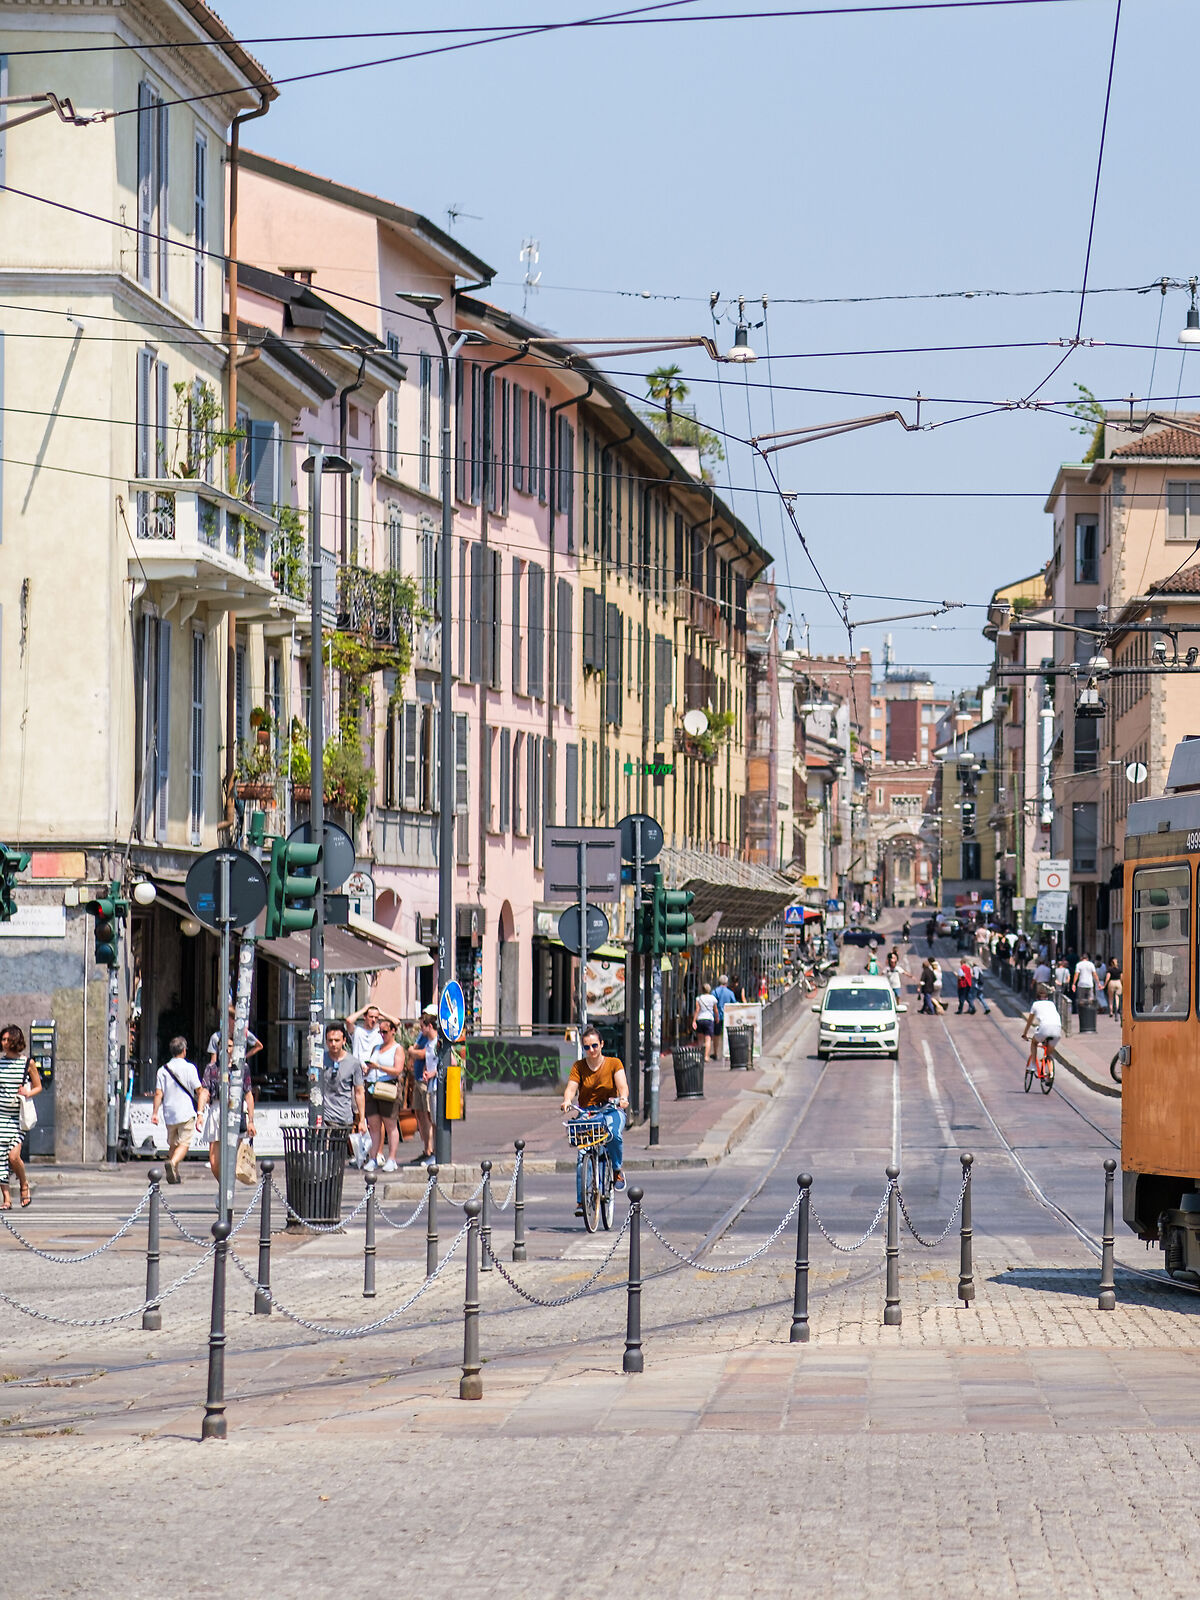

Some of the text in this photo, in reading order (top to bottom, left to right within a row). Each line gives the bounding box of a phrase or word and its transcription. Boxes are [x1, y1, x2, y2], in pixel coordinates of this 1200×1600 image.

[644, 764, 673, 775] 17/07
[280, 1110, 309, 1119] La Nost
